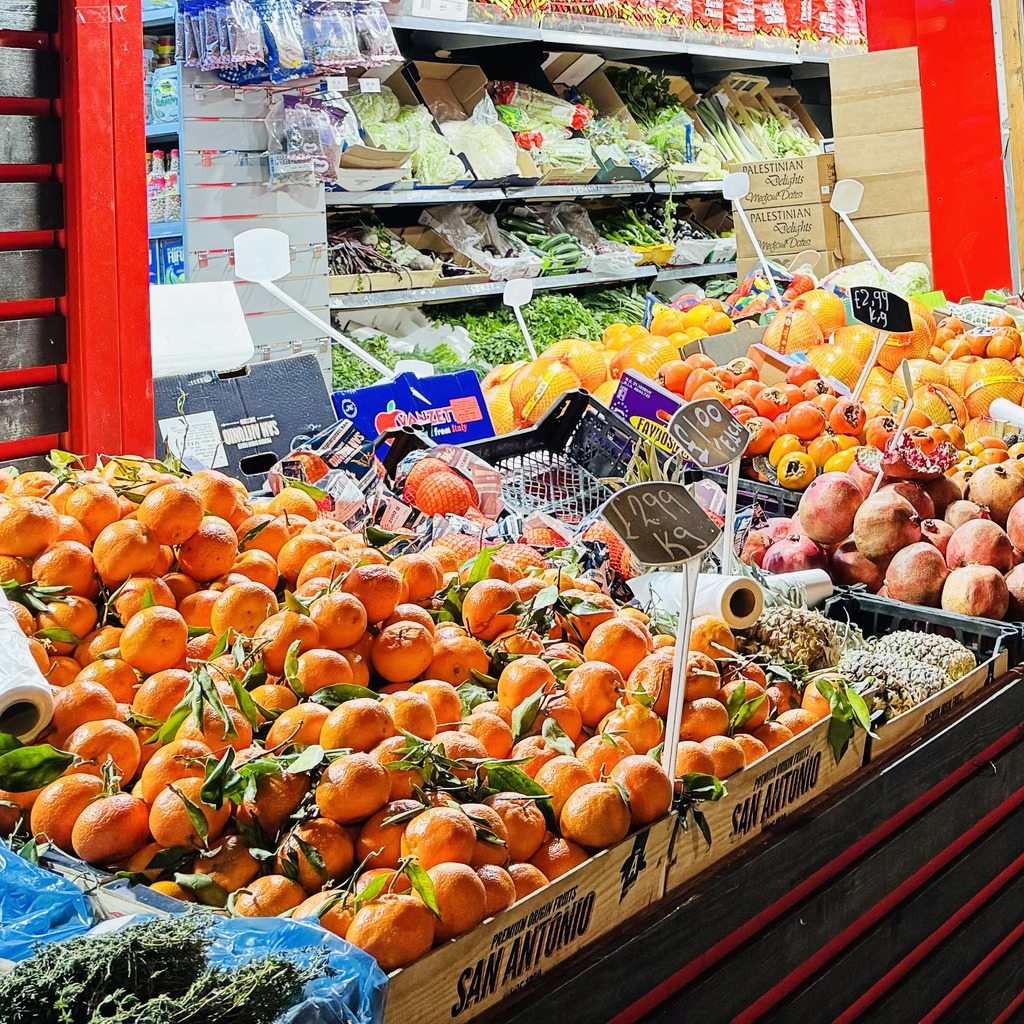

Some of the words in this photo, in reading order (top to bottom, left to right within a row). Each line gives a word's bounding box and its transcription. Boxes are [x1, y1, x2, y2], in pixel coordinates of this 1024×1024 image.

[742, 160, 803, 175] PALESTINIAN
[765, 173, 804, 189] Delights
[778, 189, 803, 201] Dates
[750, 208, 811, 223] PALESTINIAN
[773, 221, 812, 237] Delights
[786, 237, 811, 249] Dates
[221, 422, 261, 445] ANTONIO
[260, 420, 280, 438] SAN
[434, 426, 451, 437] from
[451, 423, 467, 433] Italy
[729, 789, 762, 843] SAN
[760, 751, 822, 823] ANTONIO
[490, 915, 528, 950] PREMIUM
[527, 900, 554, 927] ORIGIN
[552, 885, 579, 911] FRUITS
[451, 946, 506, 1018] SAN
[501, 890, 597, 987] ANTONIO
